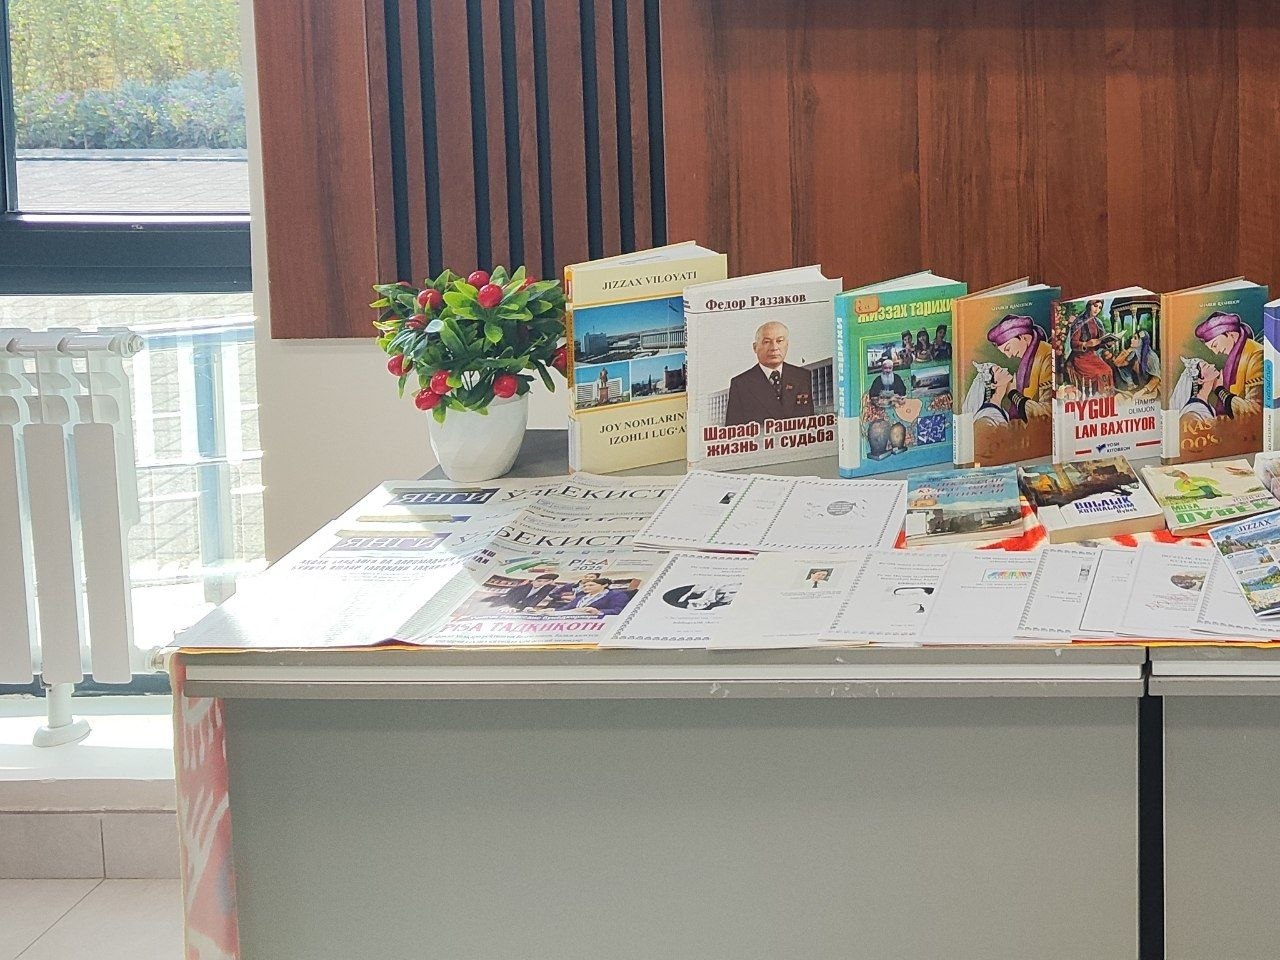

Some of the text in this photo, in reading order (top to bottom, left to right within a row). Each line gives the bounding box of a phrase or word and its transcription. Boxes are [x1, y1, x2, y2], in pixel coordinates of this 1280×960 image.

[602, 271, 698, 291] JIZZAX VILOYATI
[705, 293, 807, 312] Федор Раззаков
[599, 421, 622, 434] JOY
[703, 419, 760, 443] Шараф
[1100, 416, 1156, 437] BAXTIYOR
[608, 431, 649, 446] IZOHLI
[705, 428, 834, 458] жизнь и судьба
[1237, 518, 1272, 533] JIZZAX
